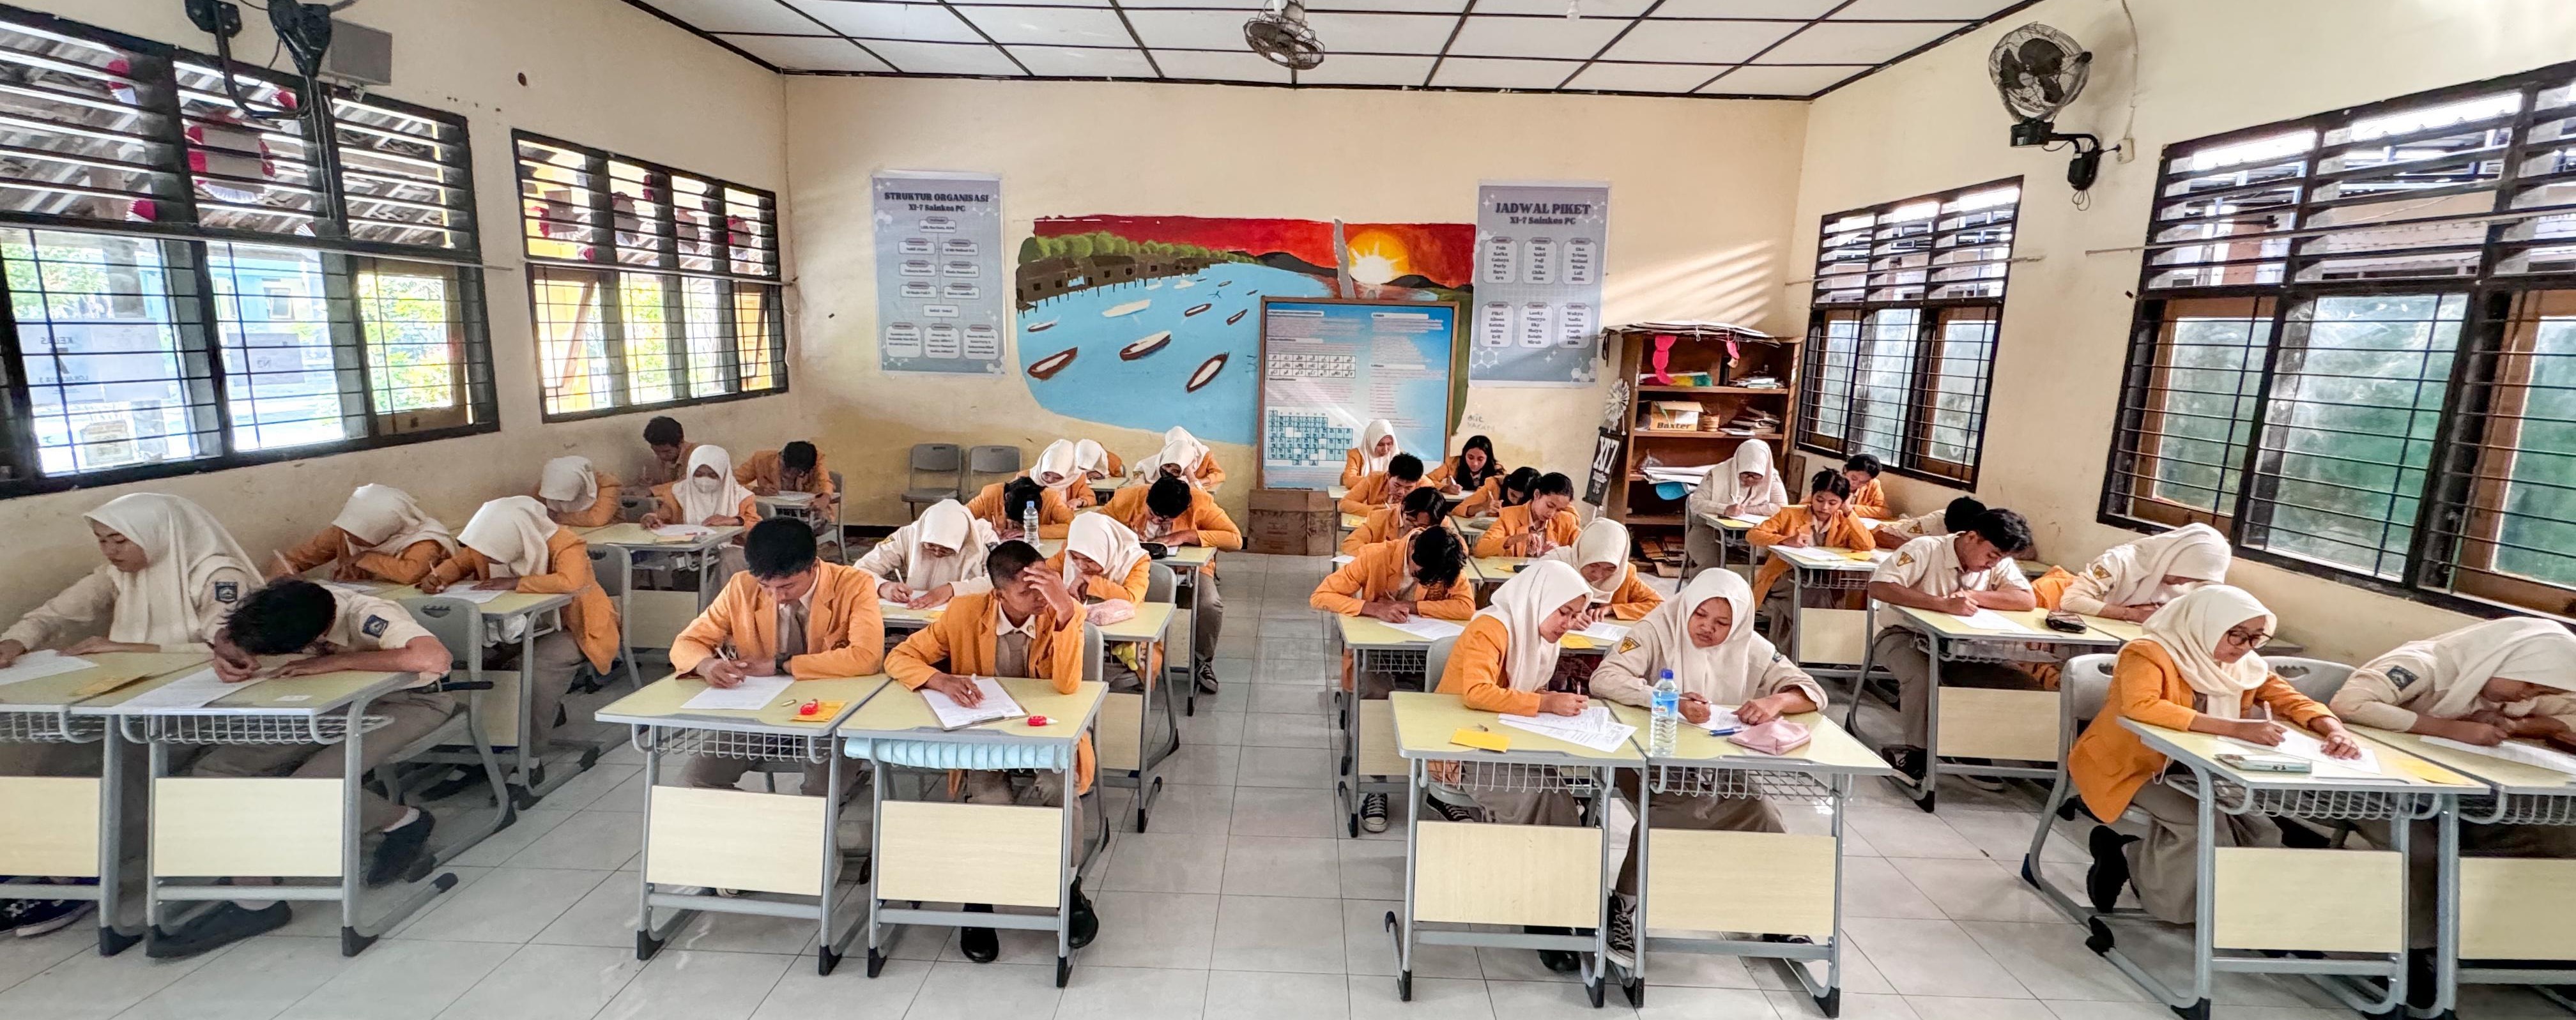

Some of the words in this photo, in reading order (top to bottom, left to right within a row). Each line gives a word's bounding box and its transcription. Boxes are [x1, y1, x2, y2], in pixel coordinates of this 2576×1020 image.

[884, 192, 931, 201] STRUKTUR
[934, 193, 989, 202] ORGANISASI
[1495, 202, 1549, 213] JADWAL
[1552, 204, 1591, 215] PIKET
